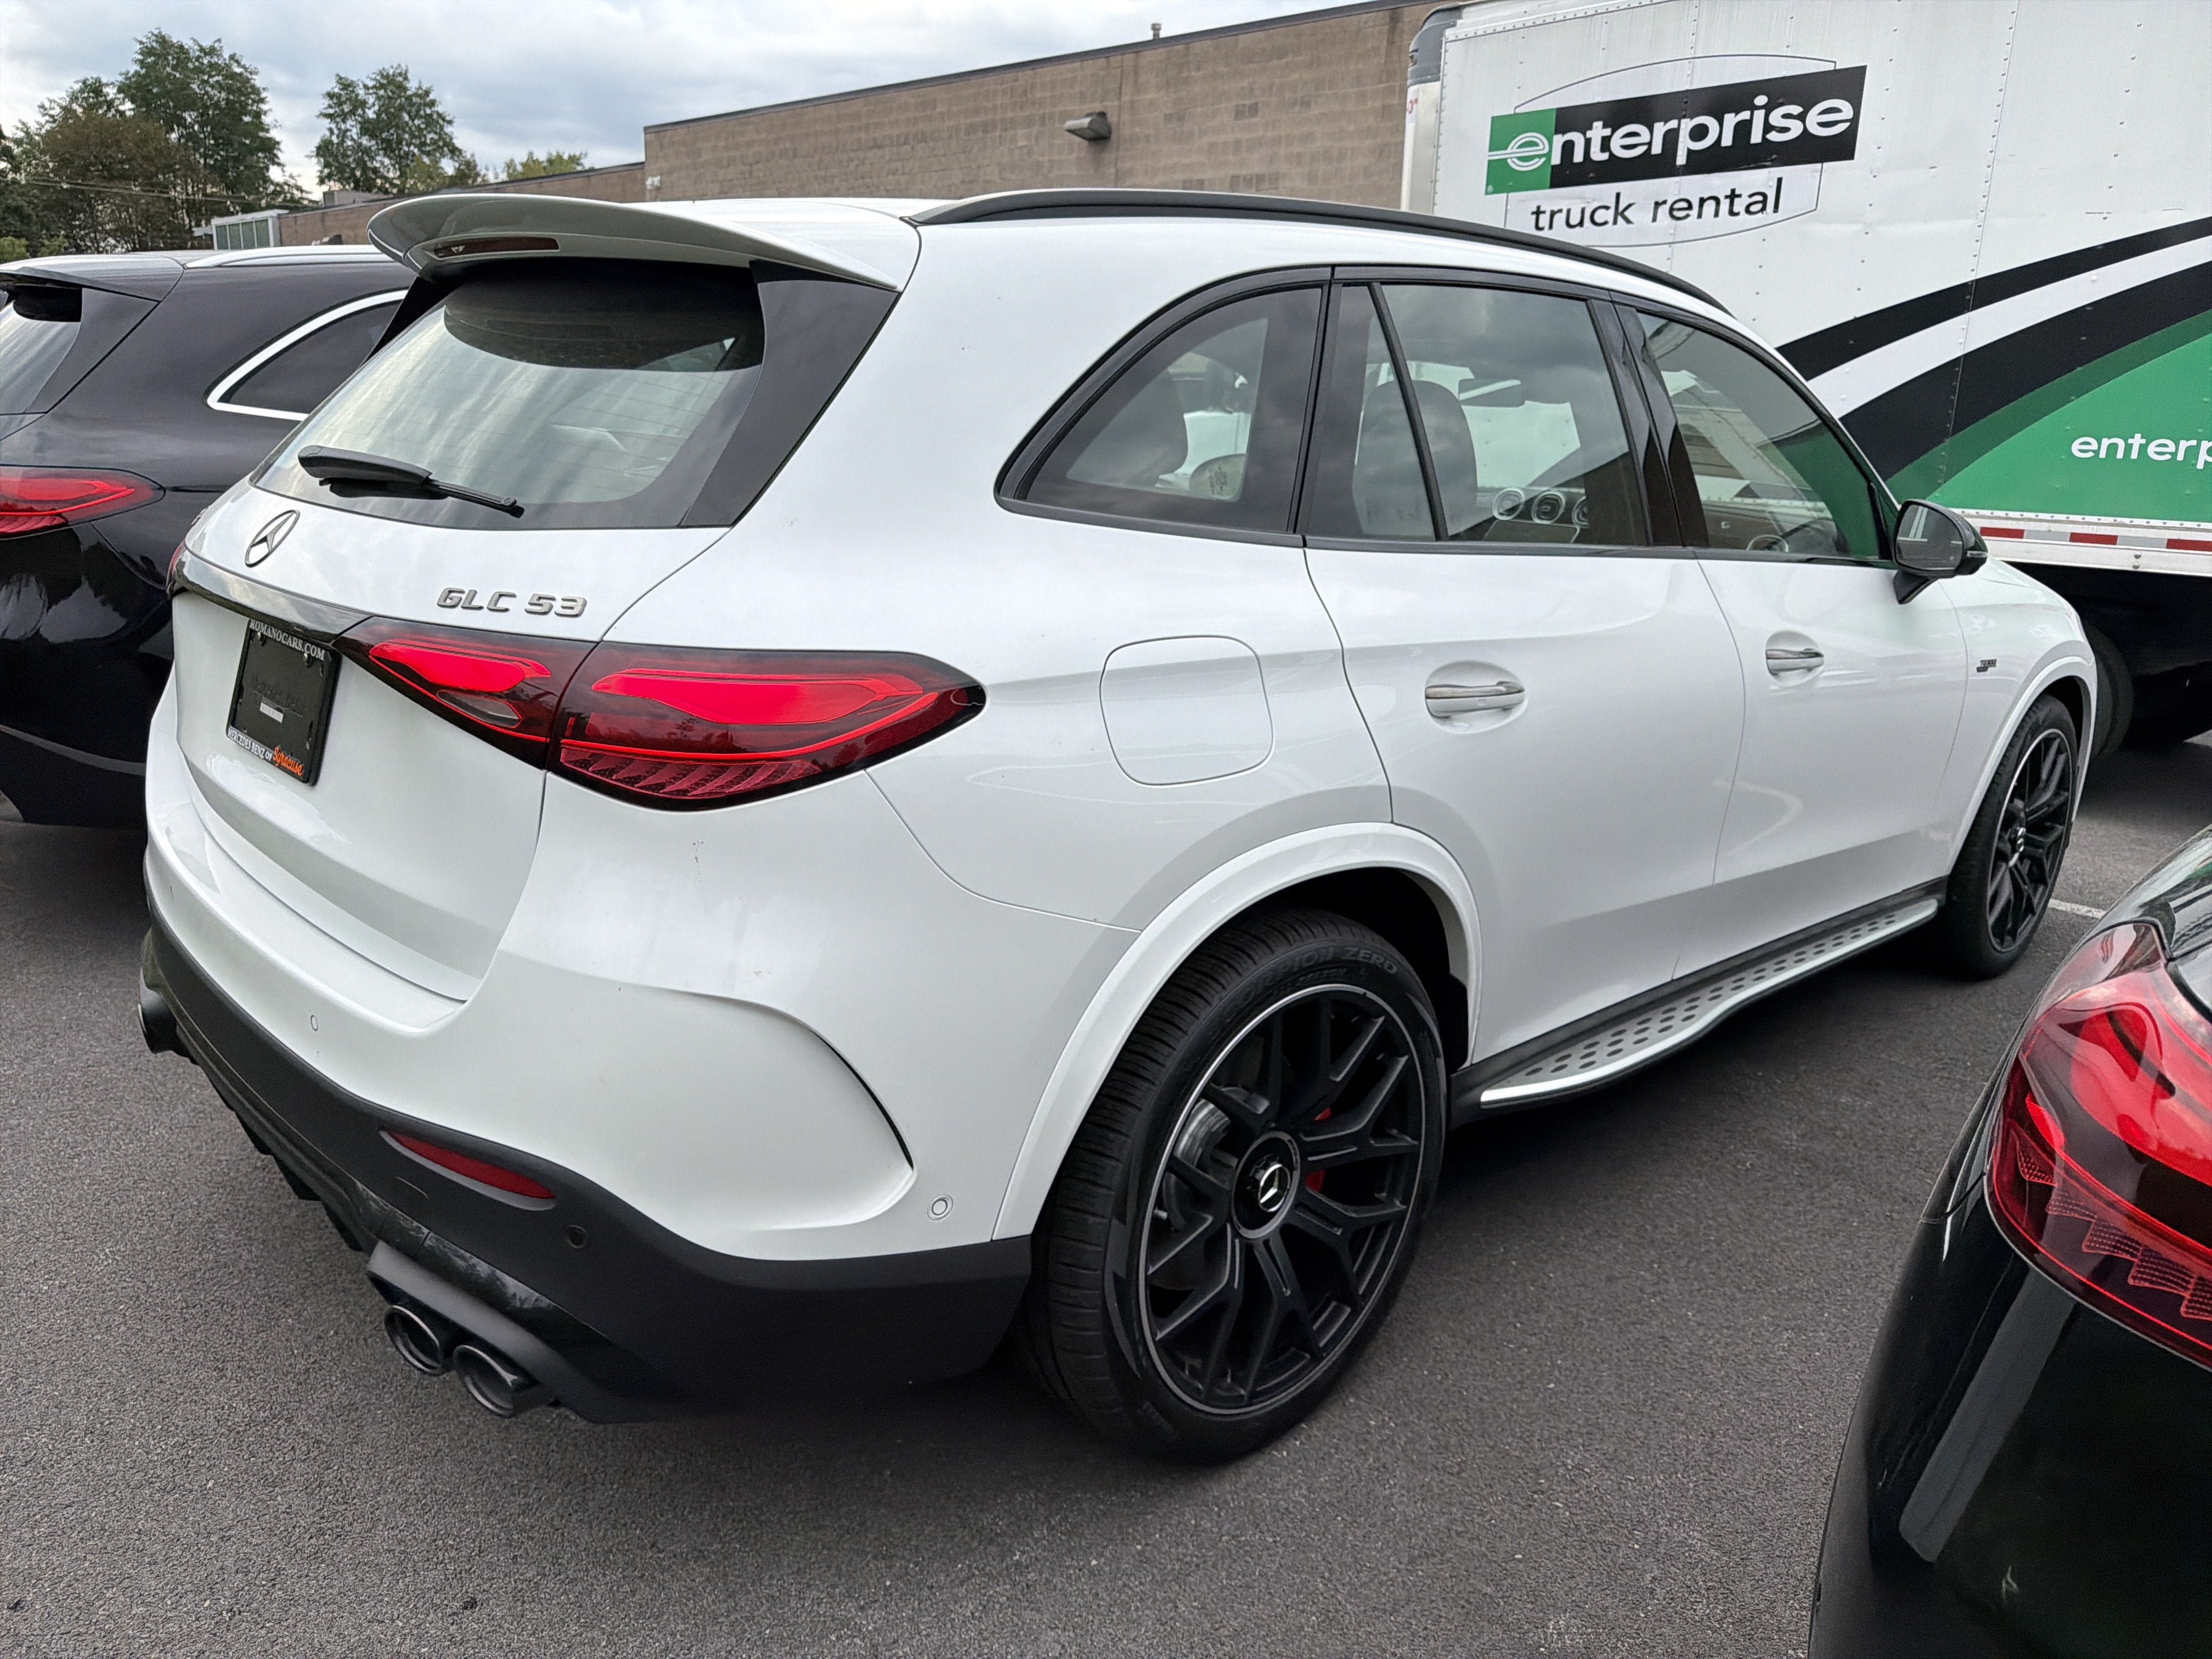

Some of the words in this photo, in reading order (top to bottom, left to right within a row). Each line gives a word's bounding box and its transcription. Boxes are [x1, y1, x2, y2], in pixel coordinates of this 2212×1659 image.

[1488, 95, 1854, 171] enterprise
[1531, 192, 1635, 230] truck
[1651, 177, 1783, 223] rental
[437, 588, 517, 613] GLC
[524, 594, 588, 618] 53
[249, 618, 325, 661] ROMANOCARS.COM
[228, 727, 251, 750] MERCEDES
[251, 742, 265, 759] BENZ
[265, 751, 273, 761] OF
[1342, 947, 1397, 974] ZERO
